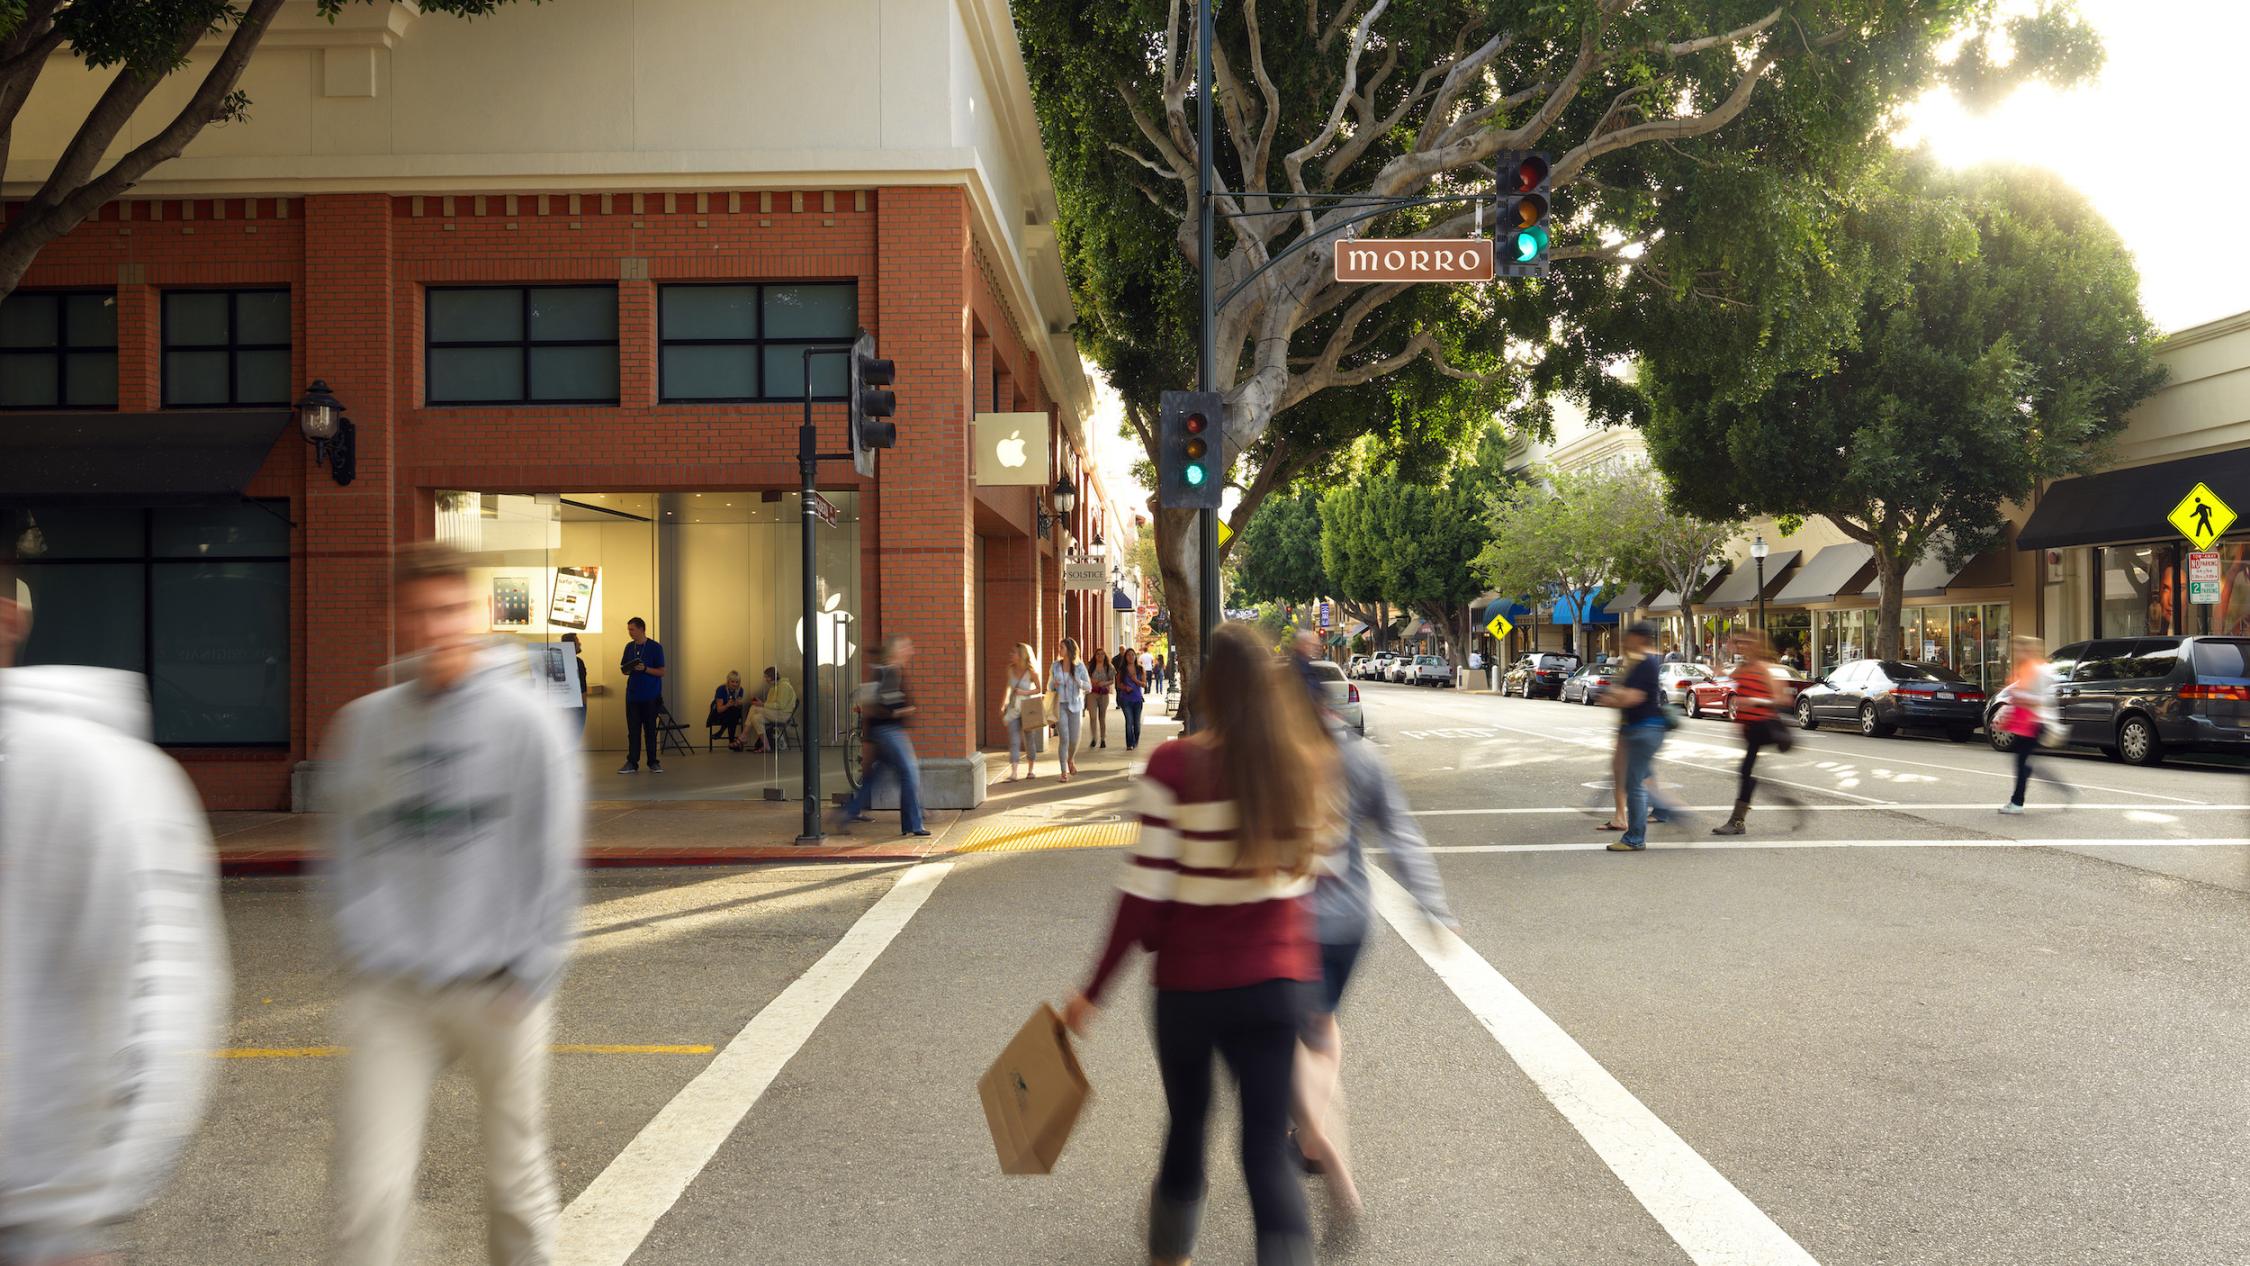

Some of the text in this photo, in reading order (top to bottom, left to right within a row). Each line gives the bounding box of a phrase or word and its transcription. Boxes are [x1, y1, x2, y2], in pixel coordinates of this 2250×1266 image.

[1349, 250, 1480, 271] MORRO
[2192, 560, 2200, 568] NO
[2193, 583, 2199, 593] 2
